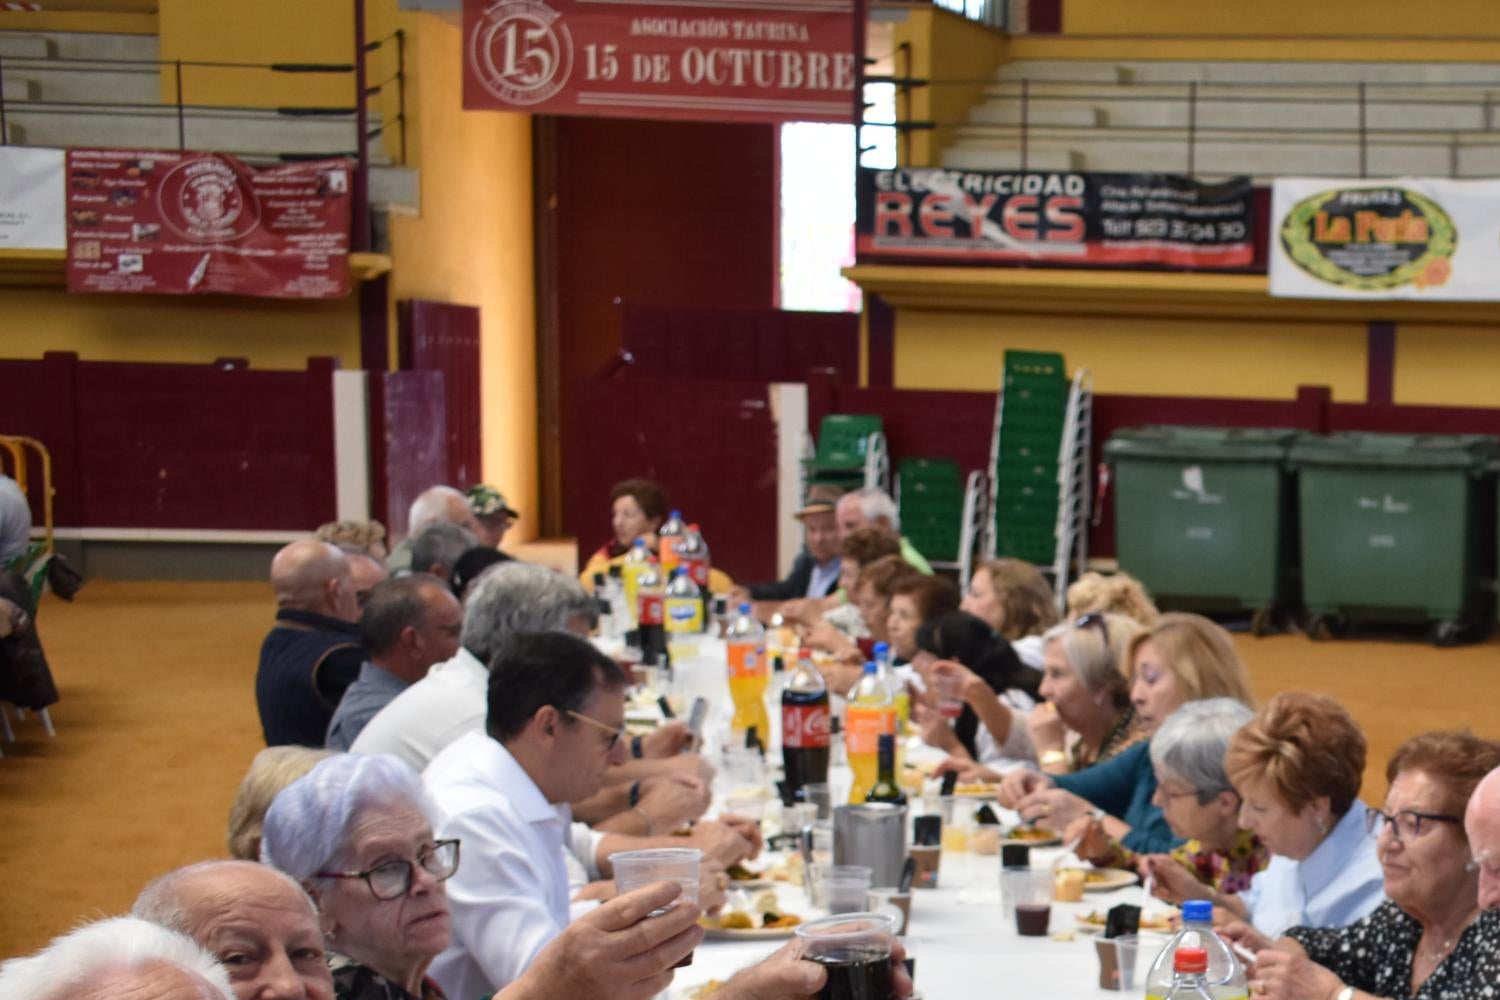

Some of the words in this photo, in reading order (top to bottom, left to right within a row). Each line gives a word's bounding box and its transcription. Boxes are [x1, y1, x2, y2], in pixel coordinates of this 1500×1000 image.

[630, 17, 727, 39] ASOCIACIÓN
[732, 21, 809, 42] TAURINA
[500, 22, 552, 85] 15
[584, 44, 618, 81] 15
[632, 54, 671, 83] DE
[682, 47, 854, 90] OCTUBRE
[876, 172, 1085, 196] ELETRICIDAD
[874, 192, 1086, 241] REYES
